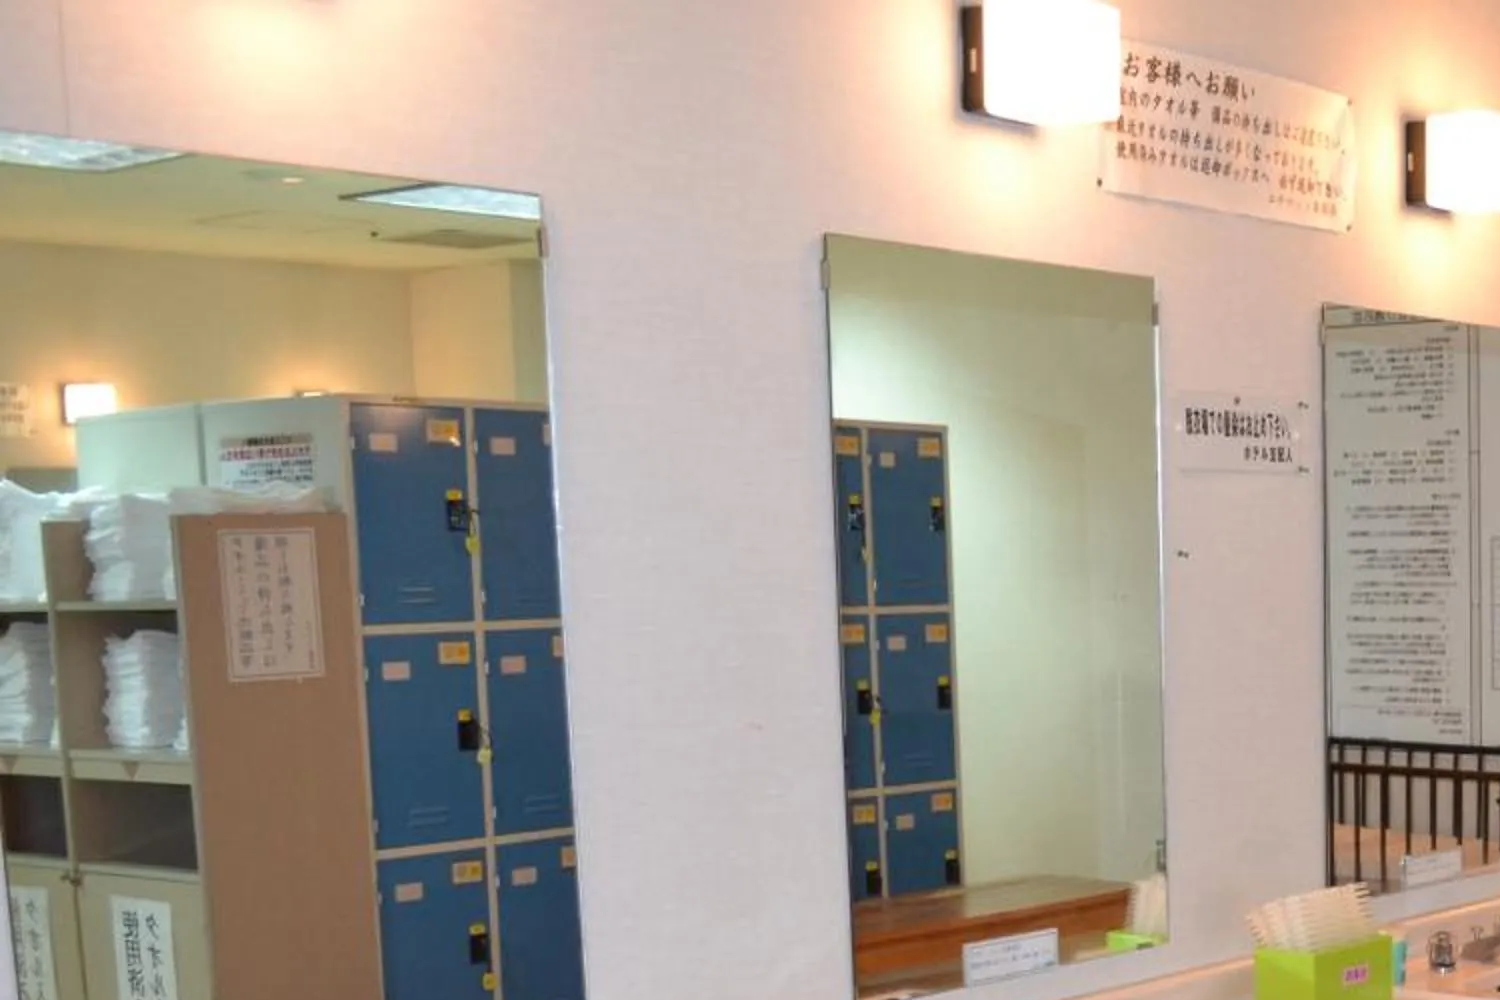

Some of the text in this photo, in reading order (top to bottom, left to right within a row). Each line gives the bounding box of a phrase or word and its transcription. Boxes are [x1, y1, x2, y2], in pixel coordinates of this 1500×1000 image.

[1123, 53, 1255, 100] お客様へお願い
